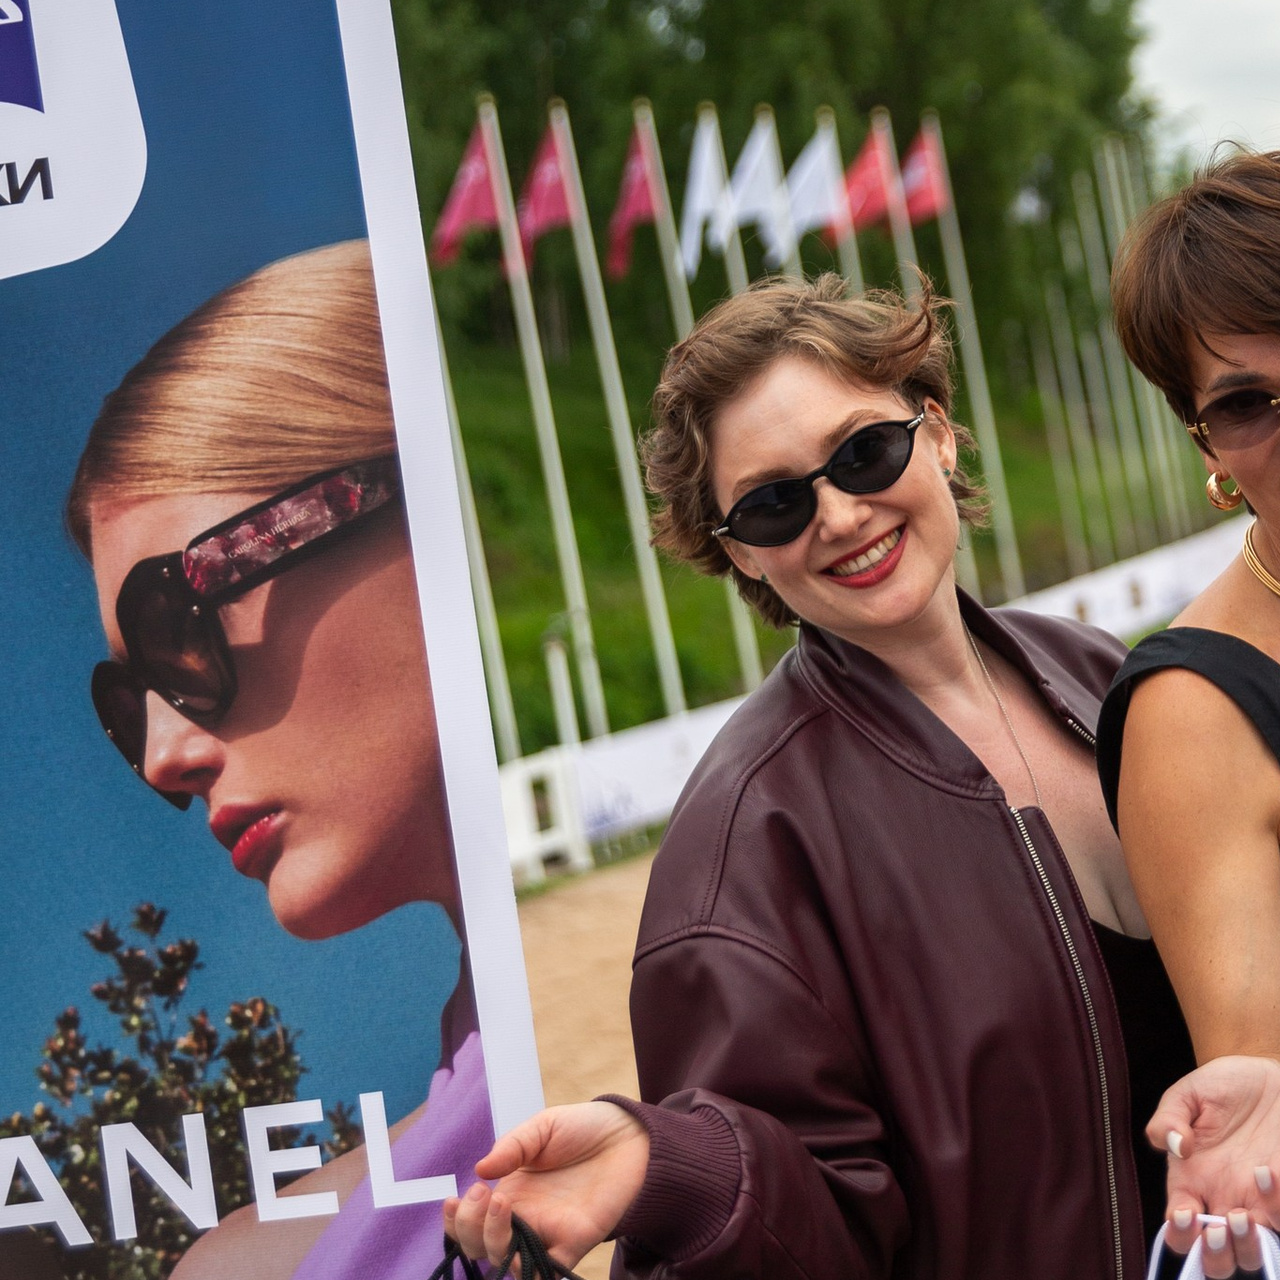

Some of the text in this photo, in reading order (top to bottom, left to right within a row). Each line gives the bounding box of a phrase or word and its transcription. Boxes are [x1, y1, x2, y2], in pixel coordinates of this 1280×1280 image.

[0, 157, 54, 206] И
[228, 531, 272, 559] CAROLINA
[0, 1091, 458, 1246] ANEL
